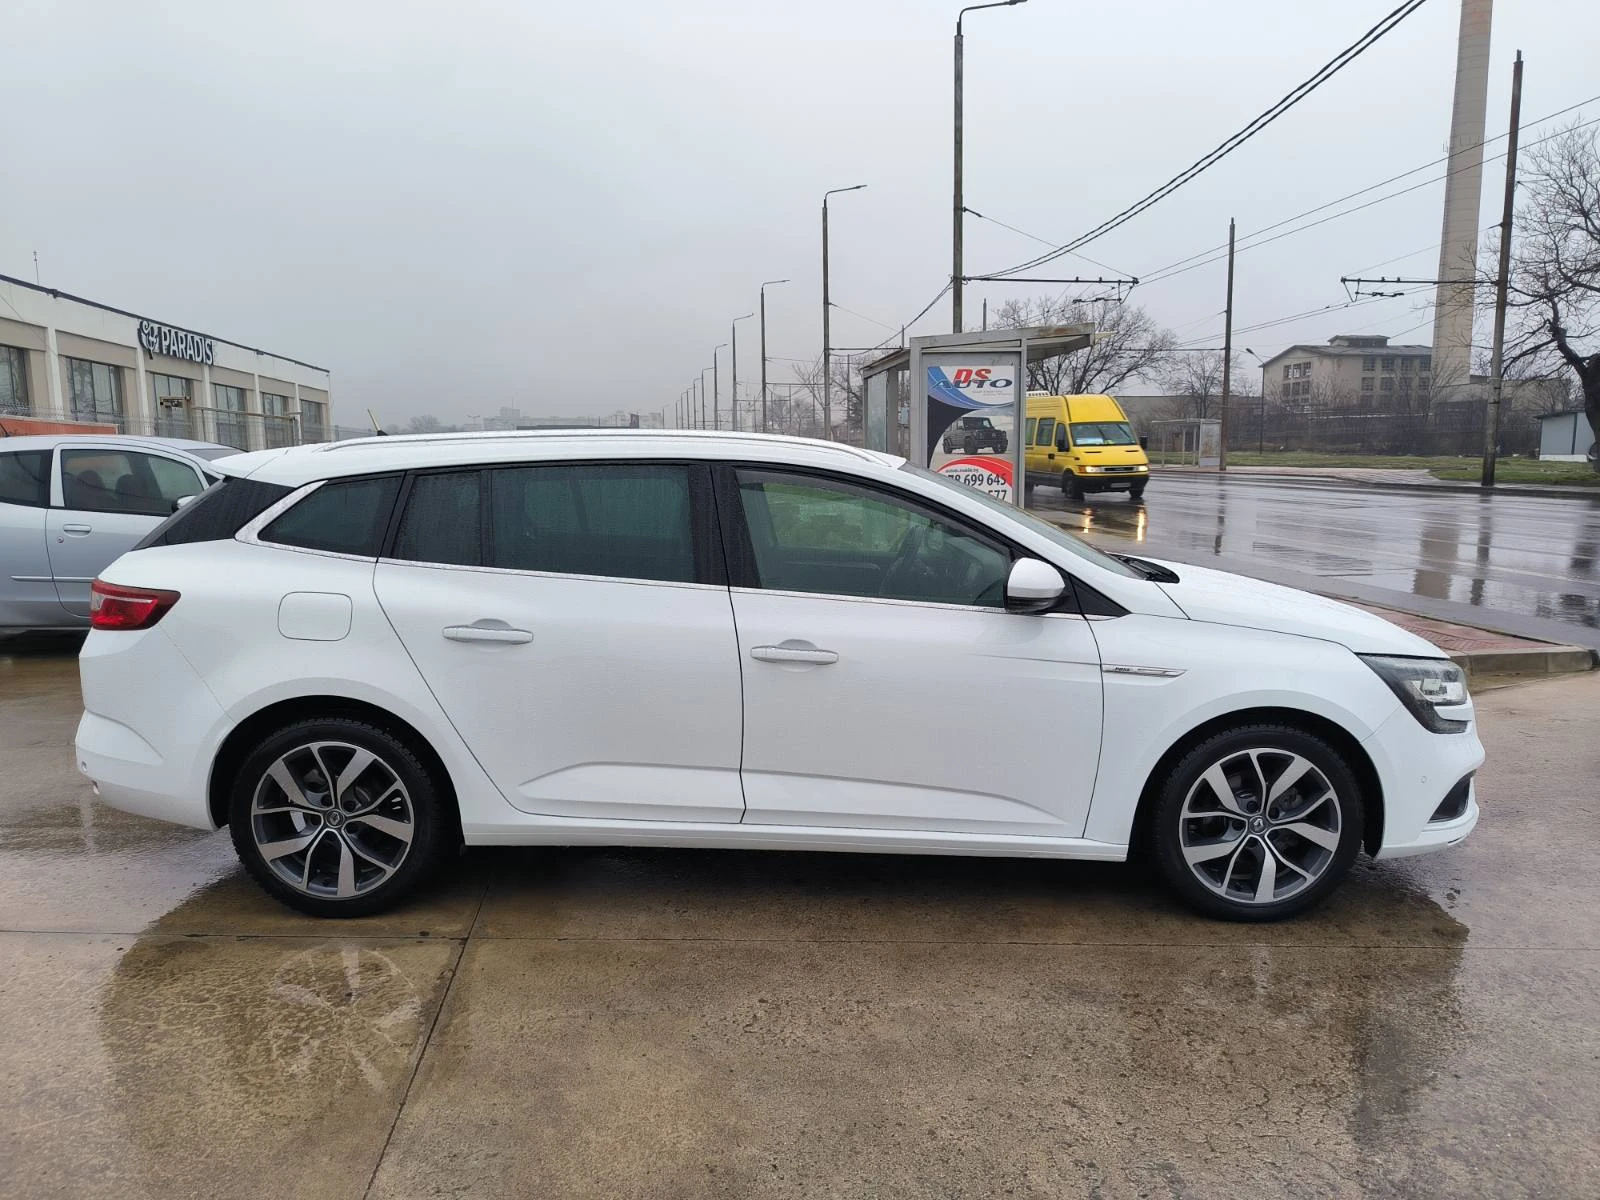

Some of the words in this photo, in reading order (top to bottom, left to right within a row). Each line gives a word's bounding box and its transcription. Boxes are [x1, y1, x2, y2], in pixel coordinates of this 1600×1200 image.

[161, 328, 214, 366] PARADIS
[932, 378, 1013, 389] AUTO
[963, 473, 984, 487] 699
[986, 473, 1007, 486] 645
